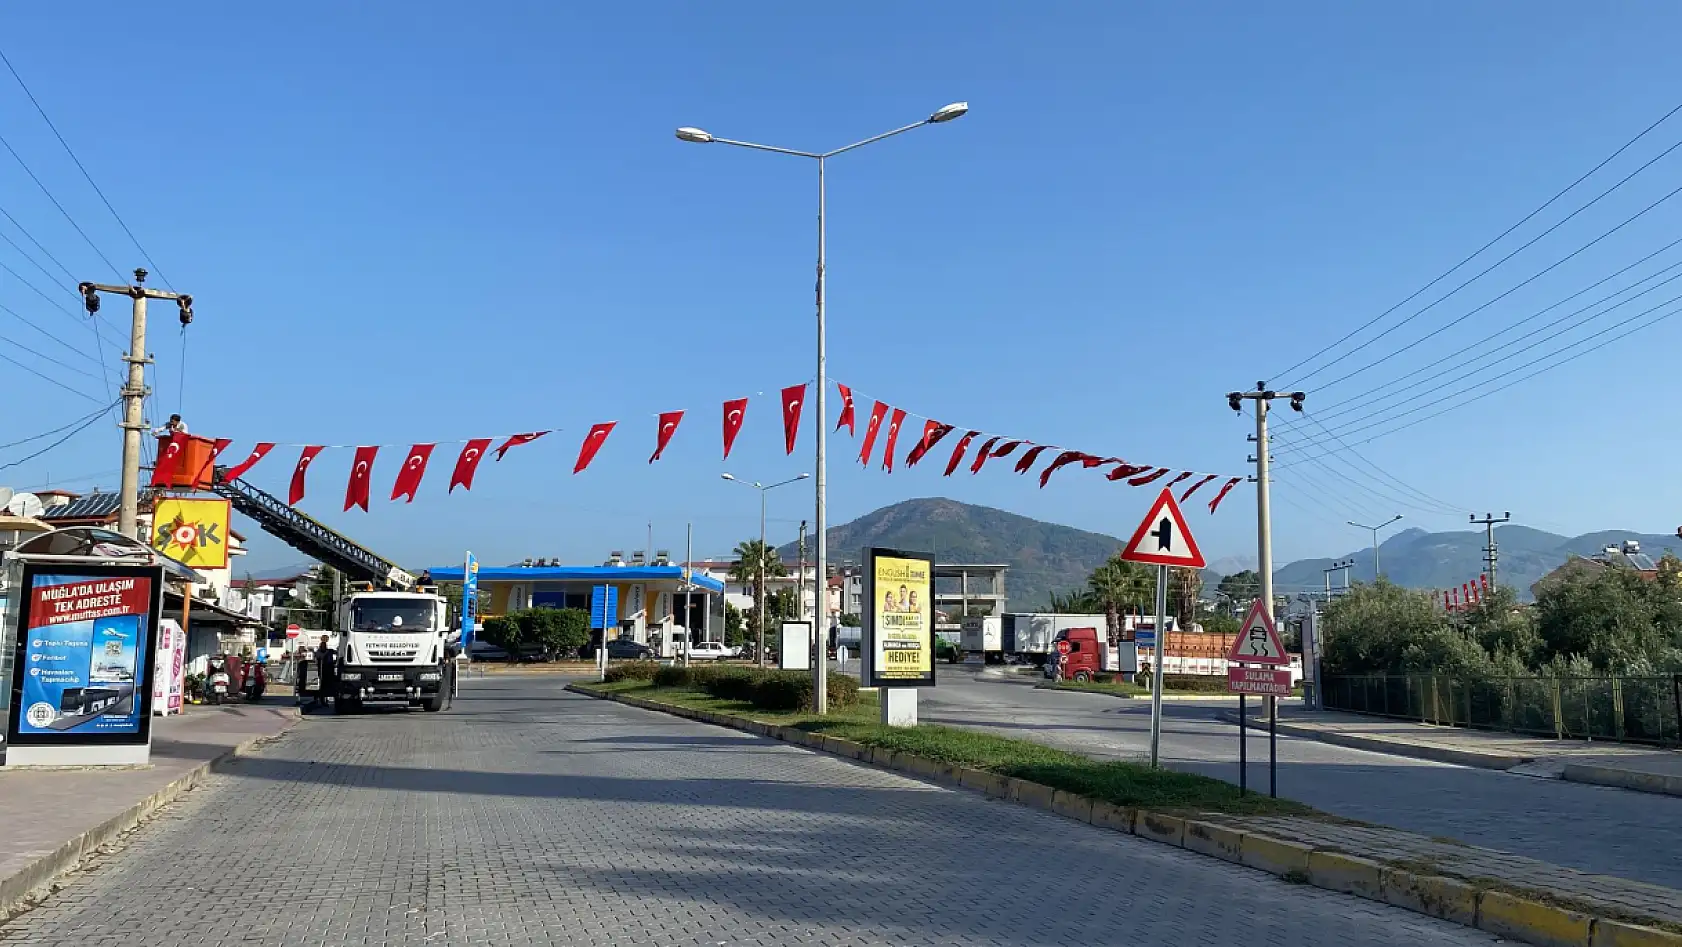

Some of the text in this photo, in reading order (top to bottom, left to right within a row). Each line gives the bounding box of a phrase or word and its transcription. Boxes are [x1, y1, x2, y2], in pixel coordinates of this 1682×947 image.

[41, 579, 134, 602] MUĞLA'DA ULAŞIM
[54, 594, 122, 613] TEK ADRESTE
[49, 606, 130, 623] www.muttas.com.tr
[1245, 671, 1274, 682] SULAMA
